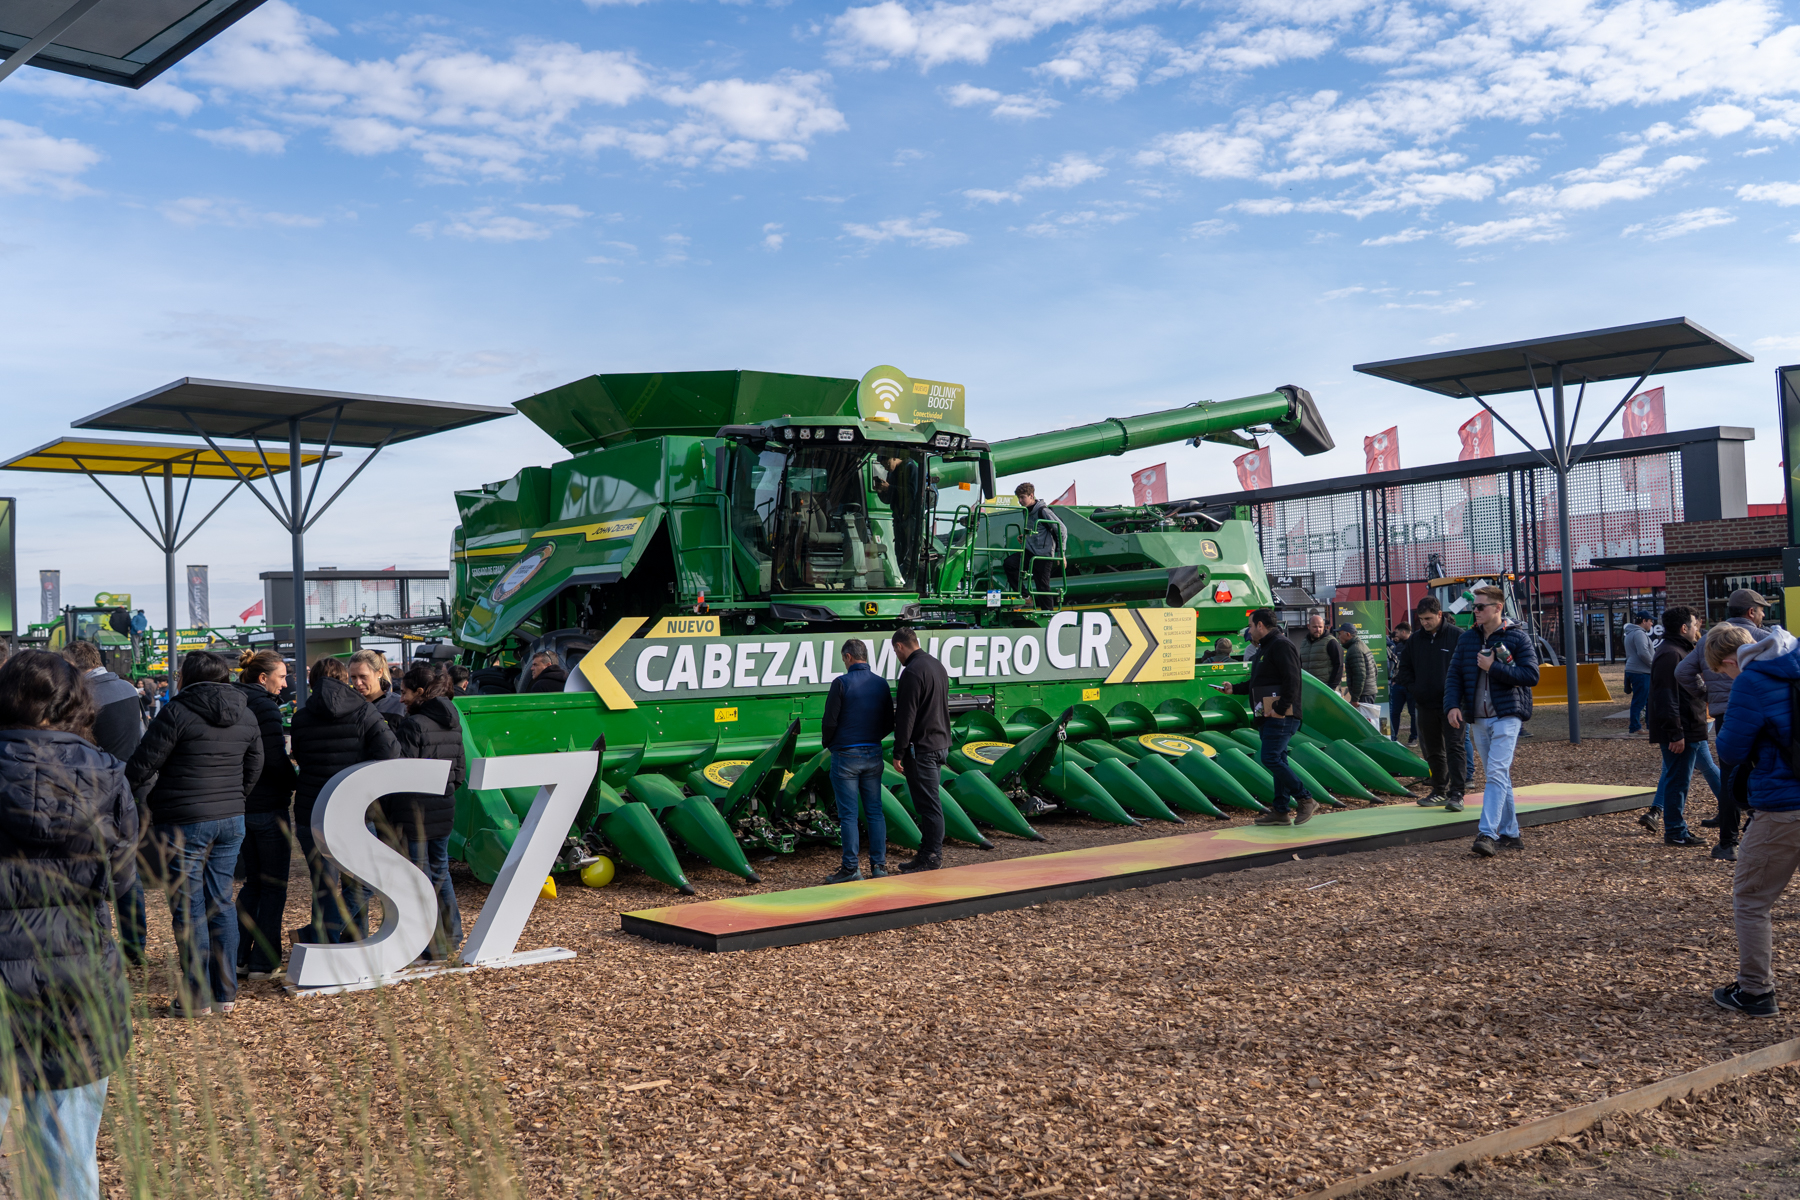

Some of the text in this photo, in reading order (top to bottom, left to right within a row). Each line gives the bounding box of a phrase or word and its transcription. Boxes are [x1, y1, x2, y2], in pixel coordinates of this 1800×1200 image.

[927, 396, 955, 410] BOOST
[592, 522, 637, 535] JOHN DEERE
[666, 619, 715, 634] NUEVO
[635, 611, 1112, 693] CABEZAL MICERO CR
[284, 750, 600, 987] S7
